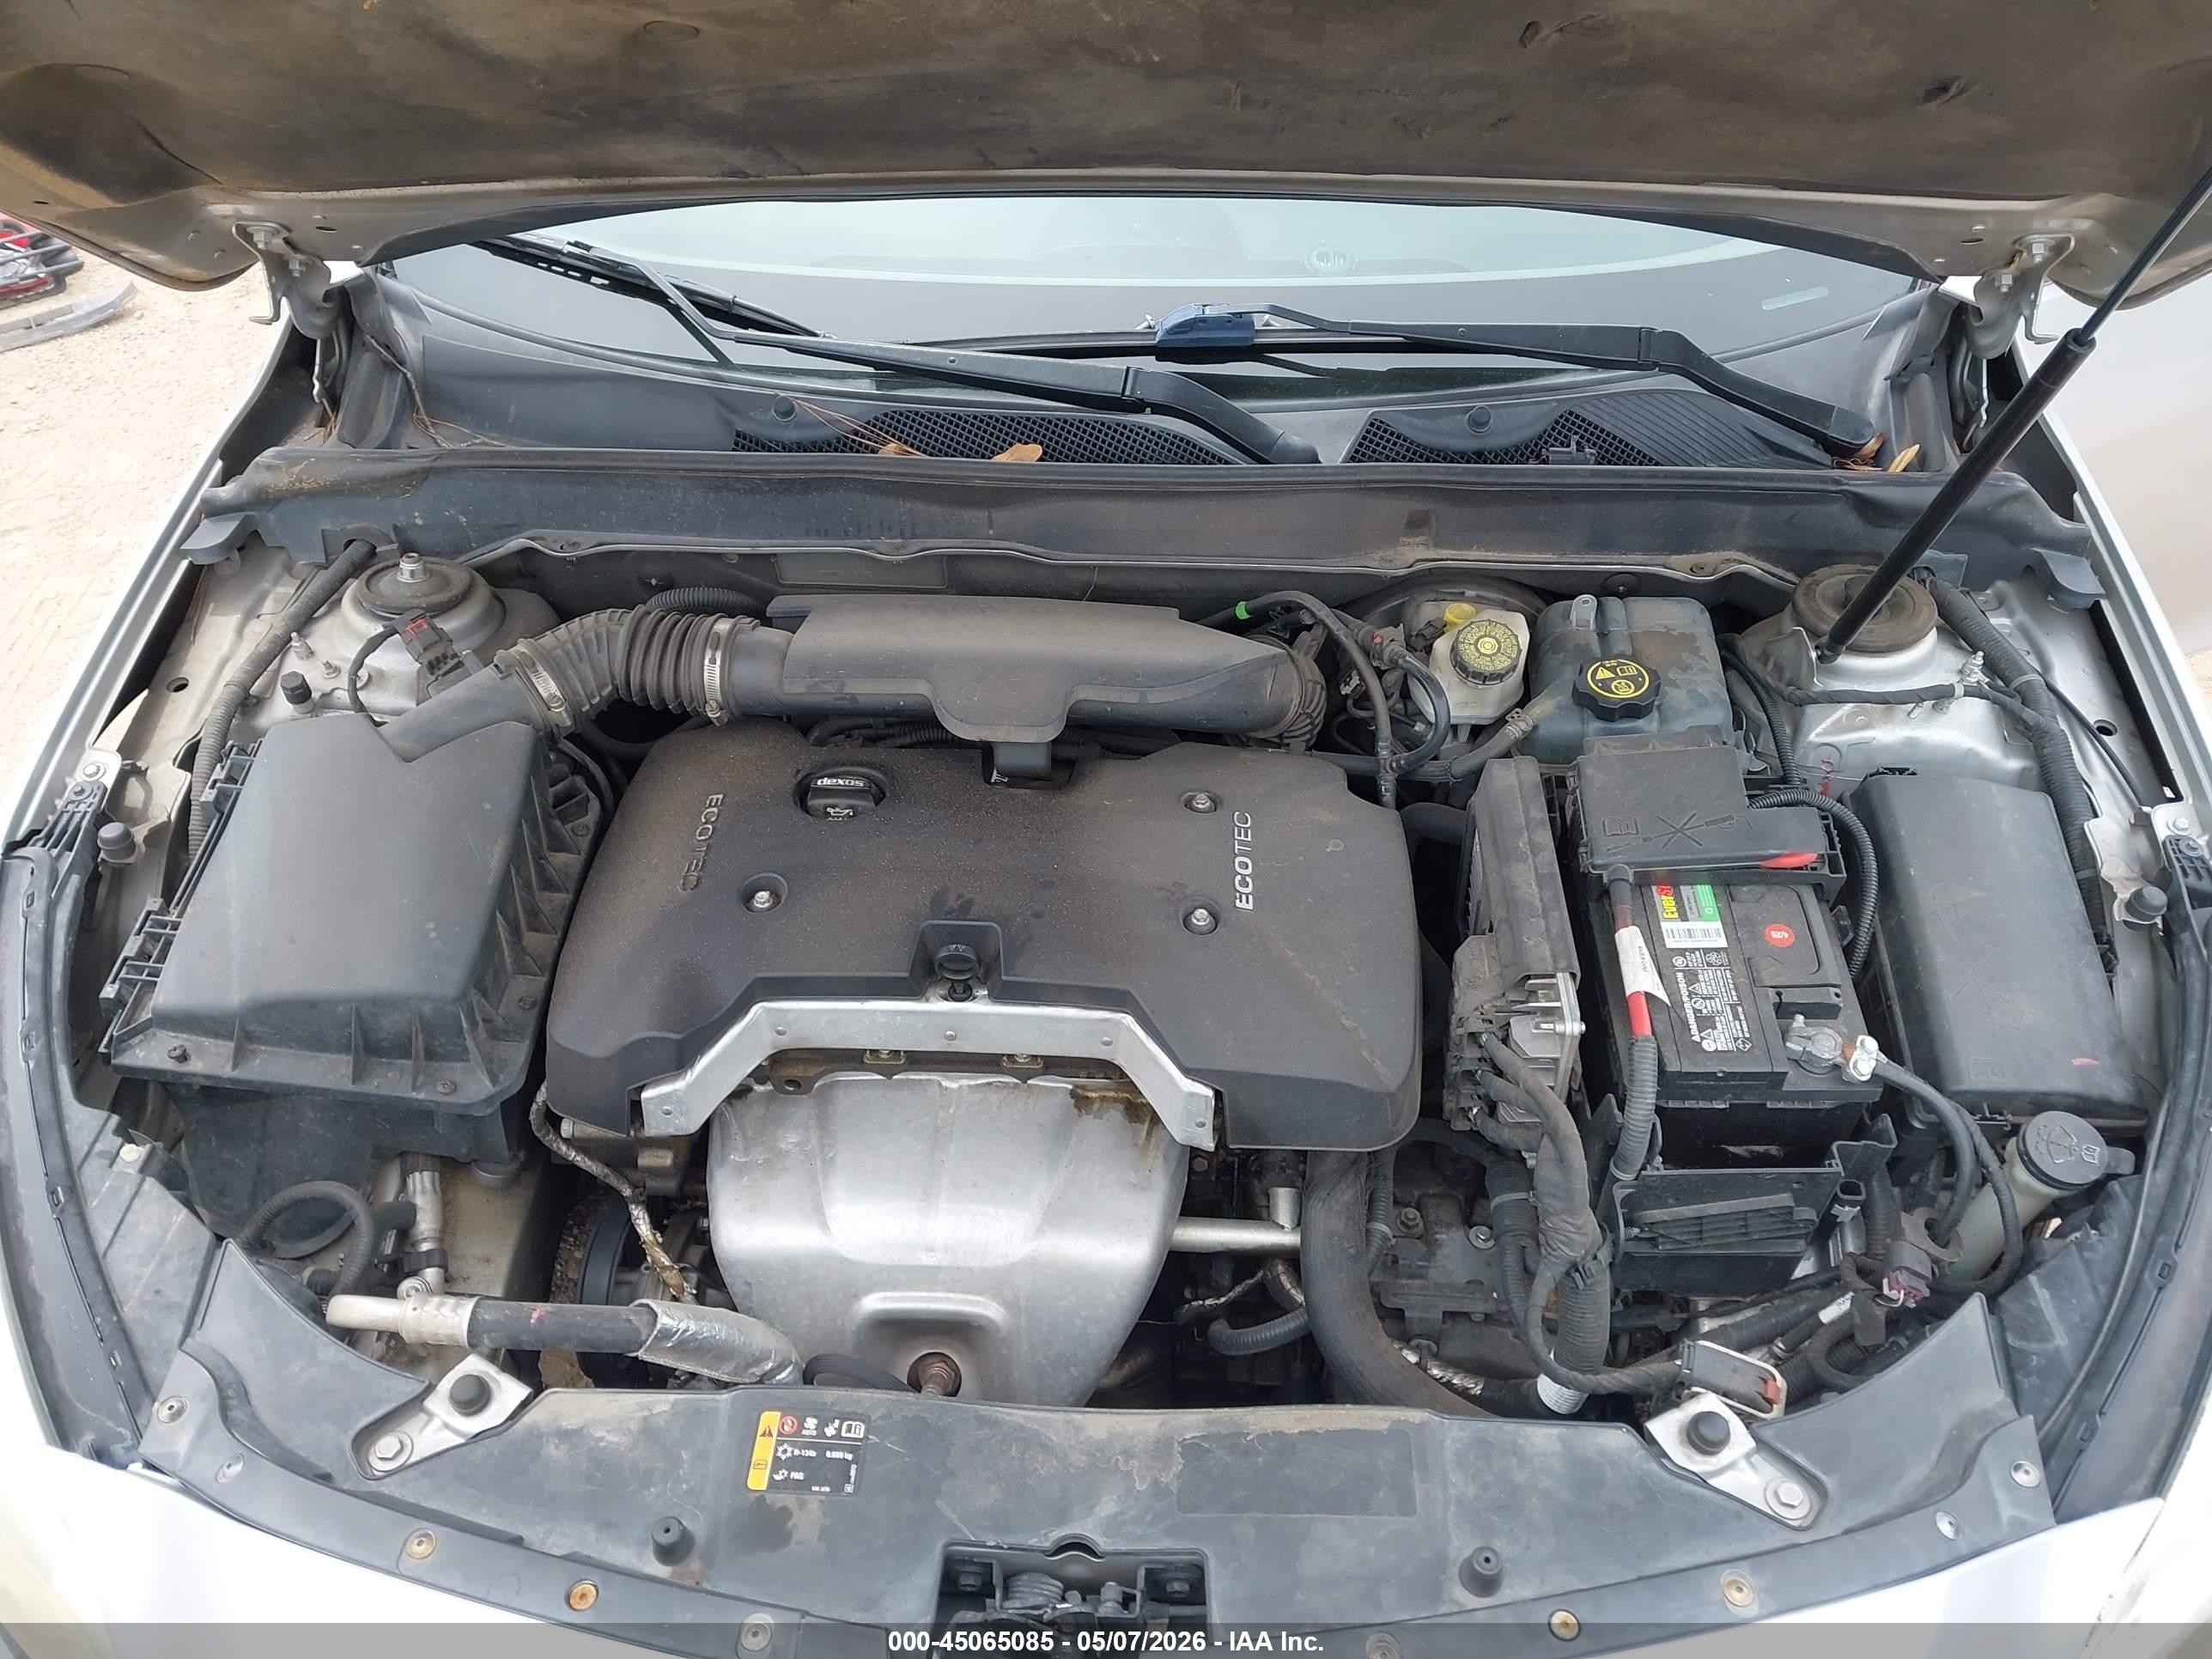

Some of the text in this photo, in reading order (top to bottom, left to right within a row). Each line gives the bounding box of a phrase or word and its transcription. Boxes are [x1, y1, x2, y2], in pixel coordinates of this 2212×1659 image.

[817, 777, 866, 787] dexos
[679, 793, 724, 892] ECOTEC
[1233, 811, 1254, 910] ECOTEC
